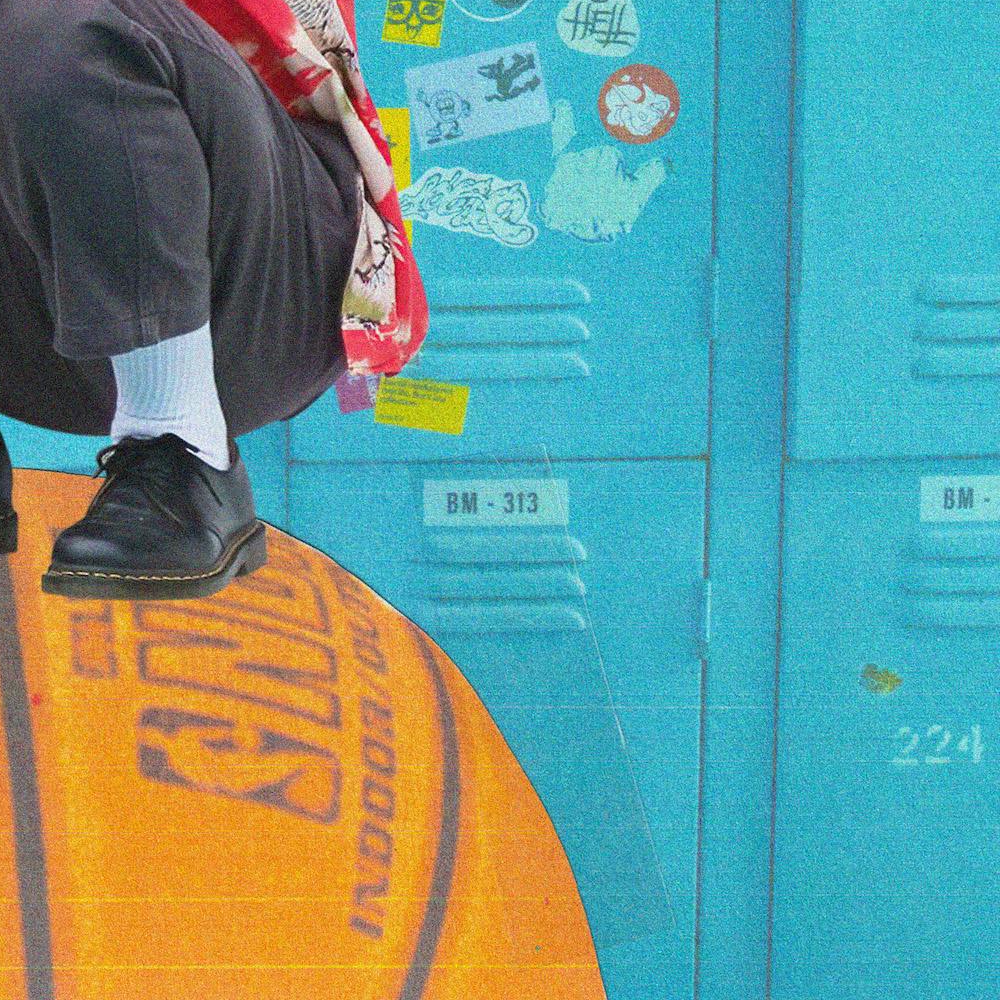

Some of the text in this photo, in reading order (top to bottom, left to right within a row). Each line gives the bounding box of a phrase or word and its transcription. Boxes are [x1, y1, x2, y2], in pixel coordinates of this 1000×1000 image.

[447, 492, 477, 514] BM
[504, 492, 538, 514] 313
[944, 486, 975, 509] BM
[893, 724, 983, 765] 224
